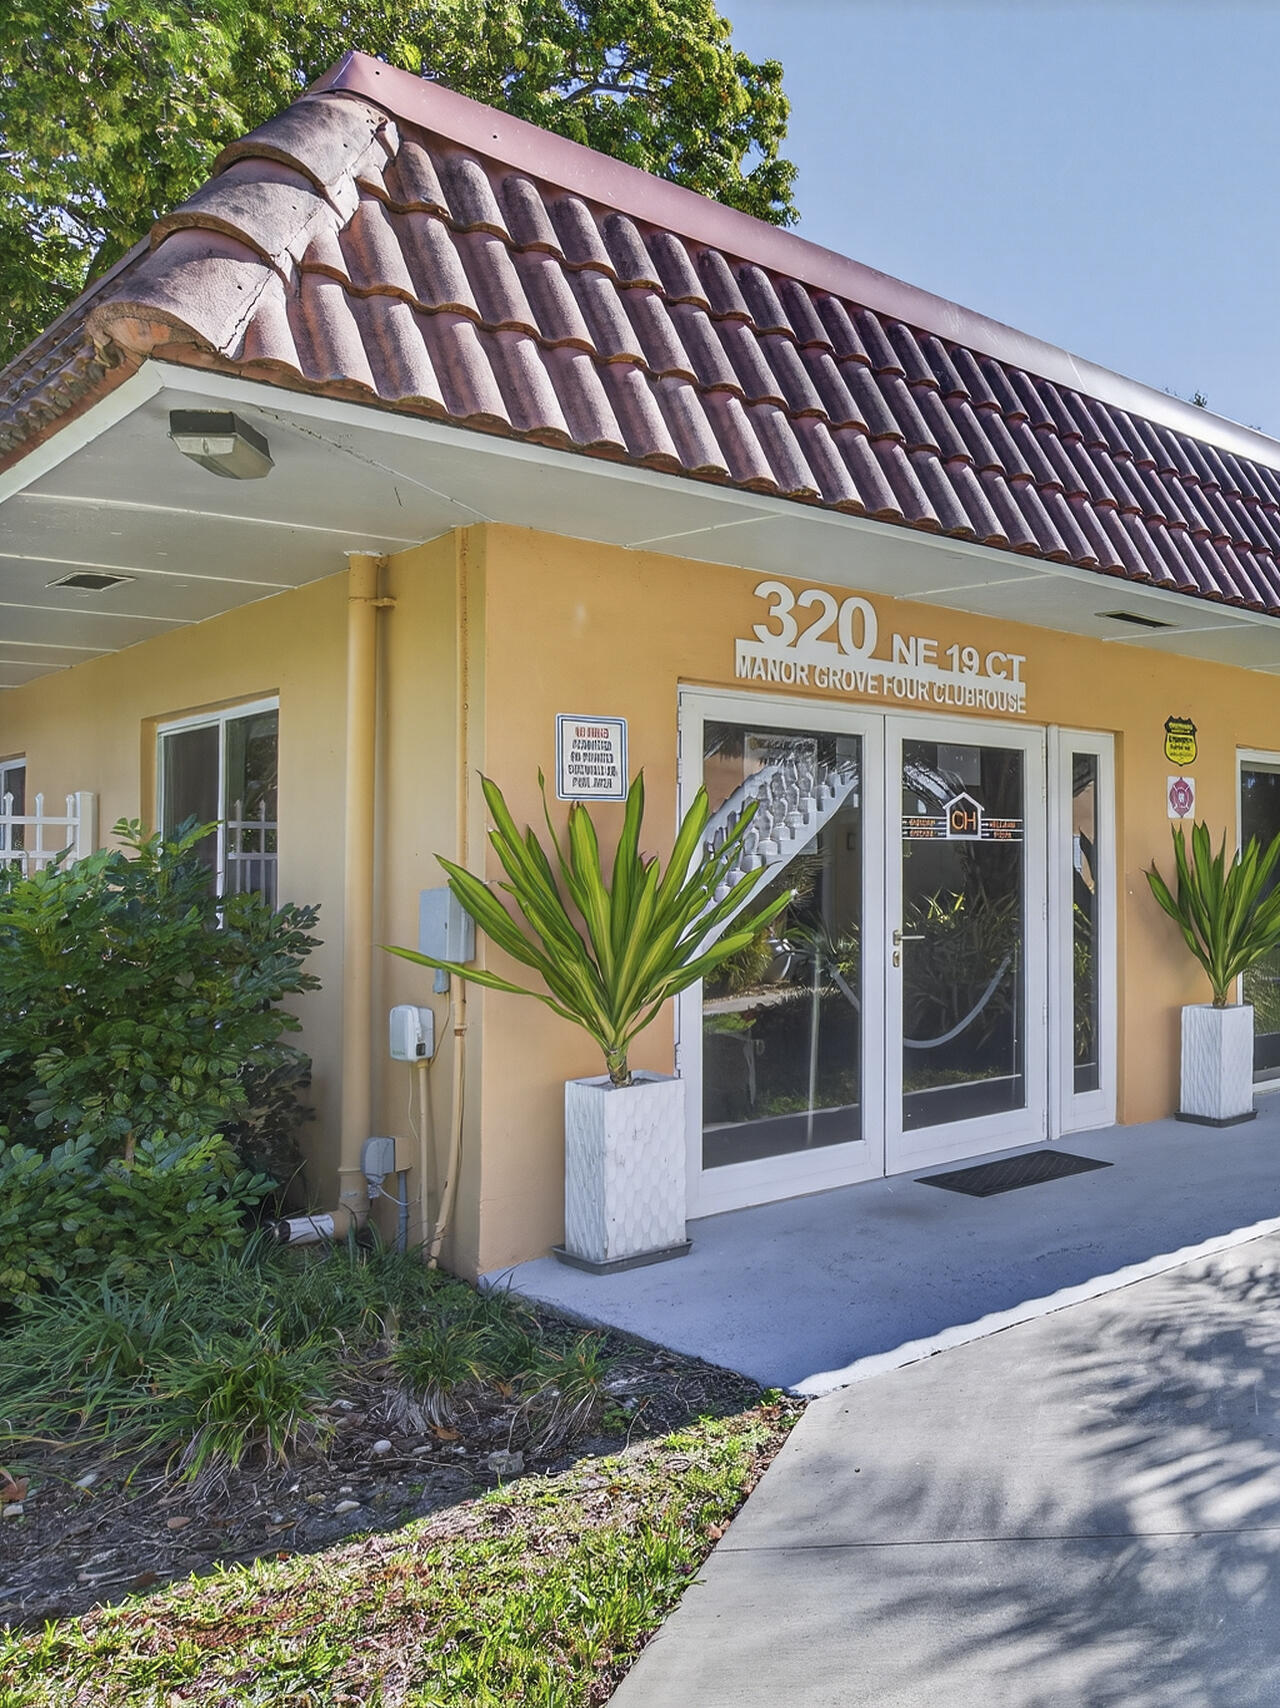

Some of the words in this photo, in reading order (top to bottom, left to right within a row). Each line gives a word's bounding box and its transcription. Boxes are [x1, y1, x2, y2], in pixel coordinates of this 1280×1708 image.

[752, 580, 878, 659] 320
[892, 633, 938, 668] NE
[945, 643, 979, 677] 19
[985, 650, 1027, 682] CT
[736, 654, 809, 686] MANOR
[813, 664, 879, 695] GROVE
[882, 676, 930, 702] FOUR
[932, 682, 1027, 714] CLUBHOUSE
[951, 810, 976, 831] CH
